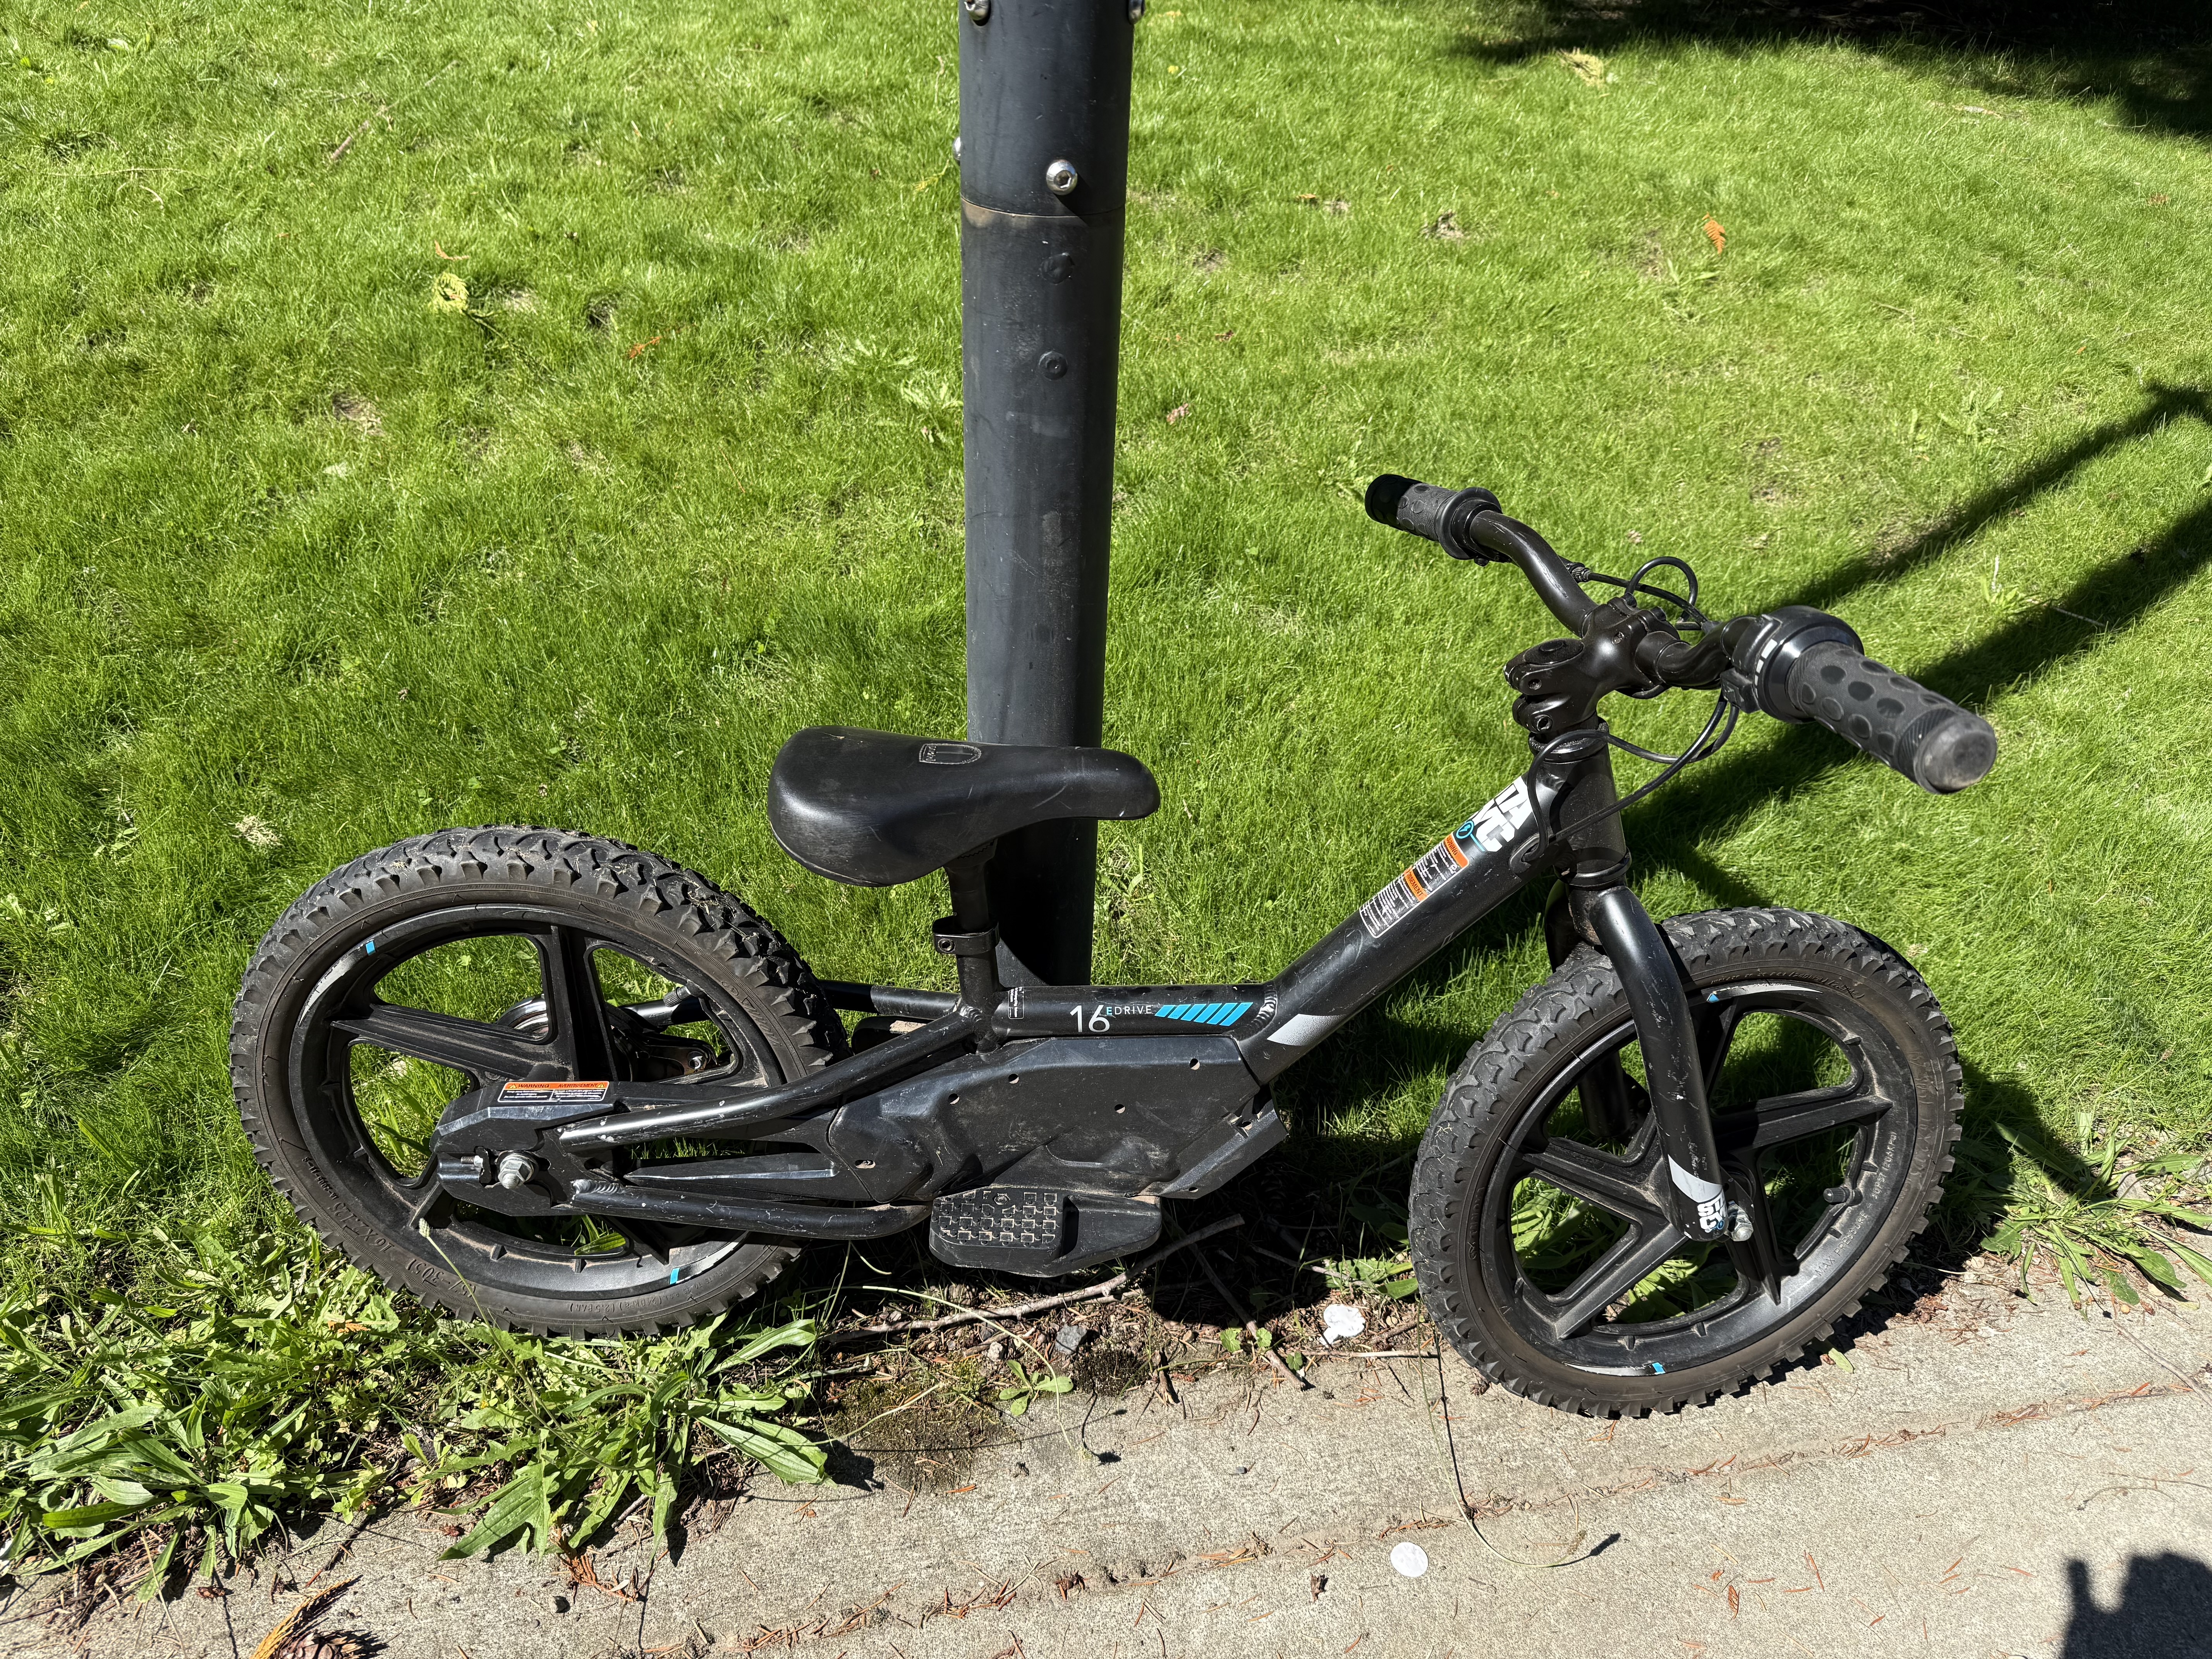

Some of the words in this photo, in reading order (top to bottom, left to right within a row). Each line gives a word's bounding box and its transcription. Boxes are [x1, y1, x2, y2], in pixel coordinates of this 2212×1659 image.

[1070, 1005, 1110, 1033] 16
[1106, 1005, 1152, 1015] EDRIVE
[1815, 1256, 1836, 1276] MAX
[1834, 1210, 1869, 1256] PRESSURE
